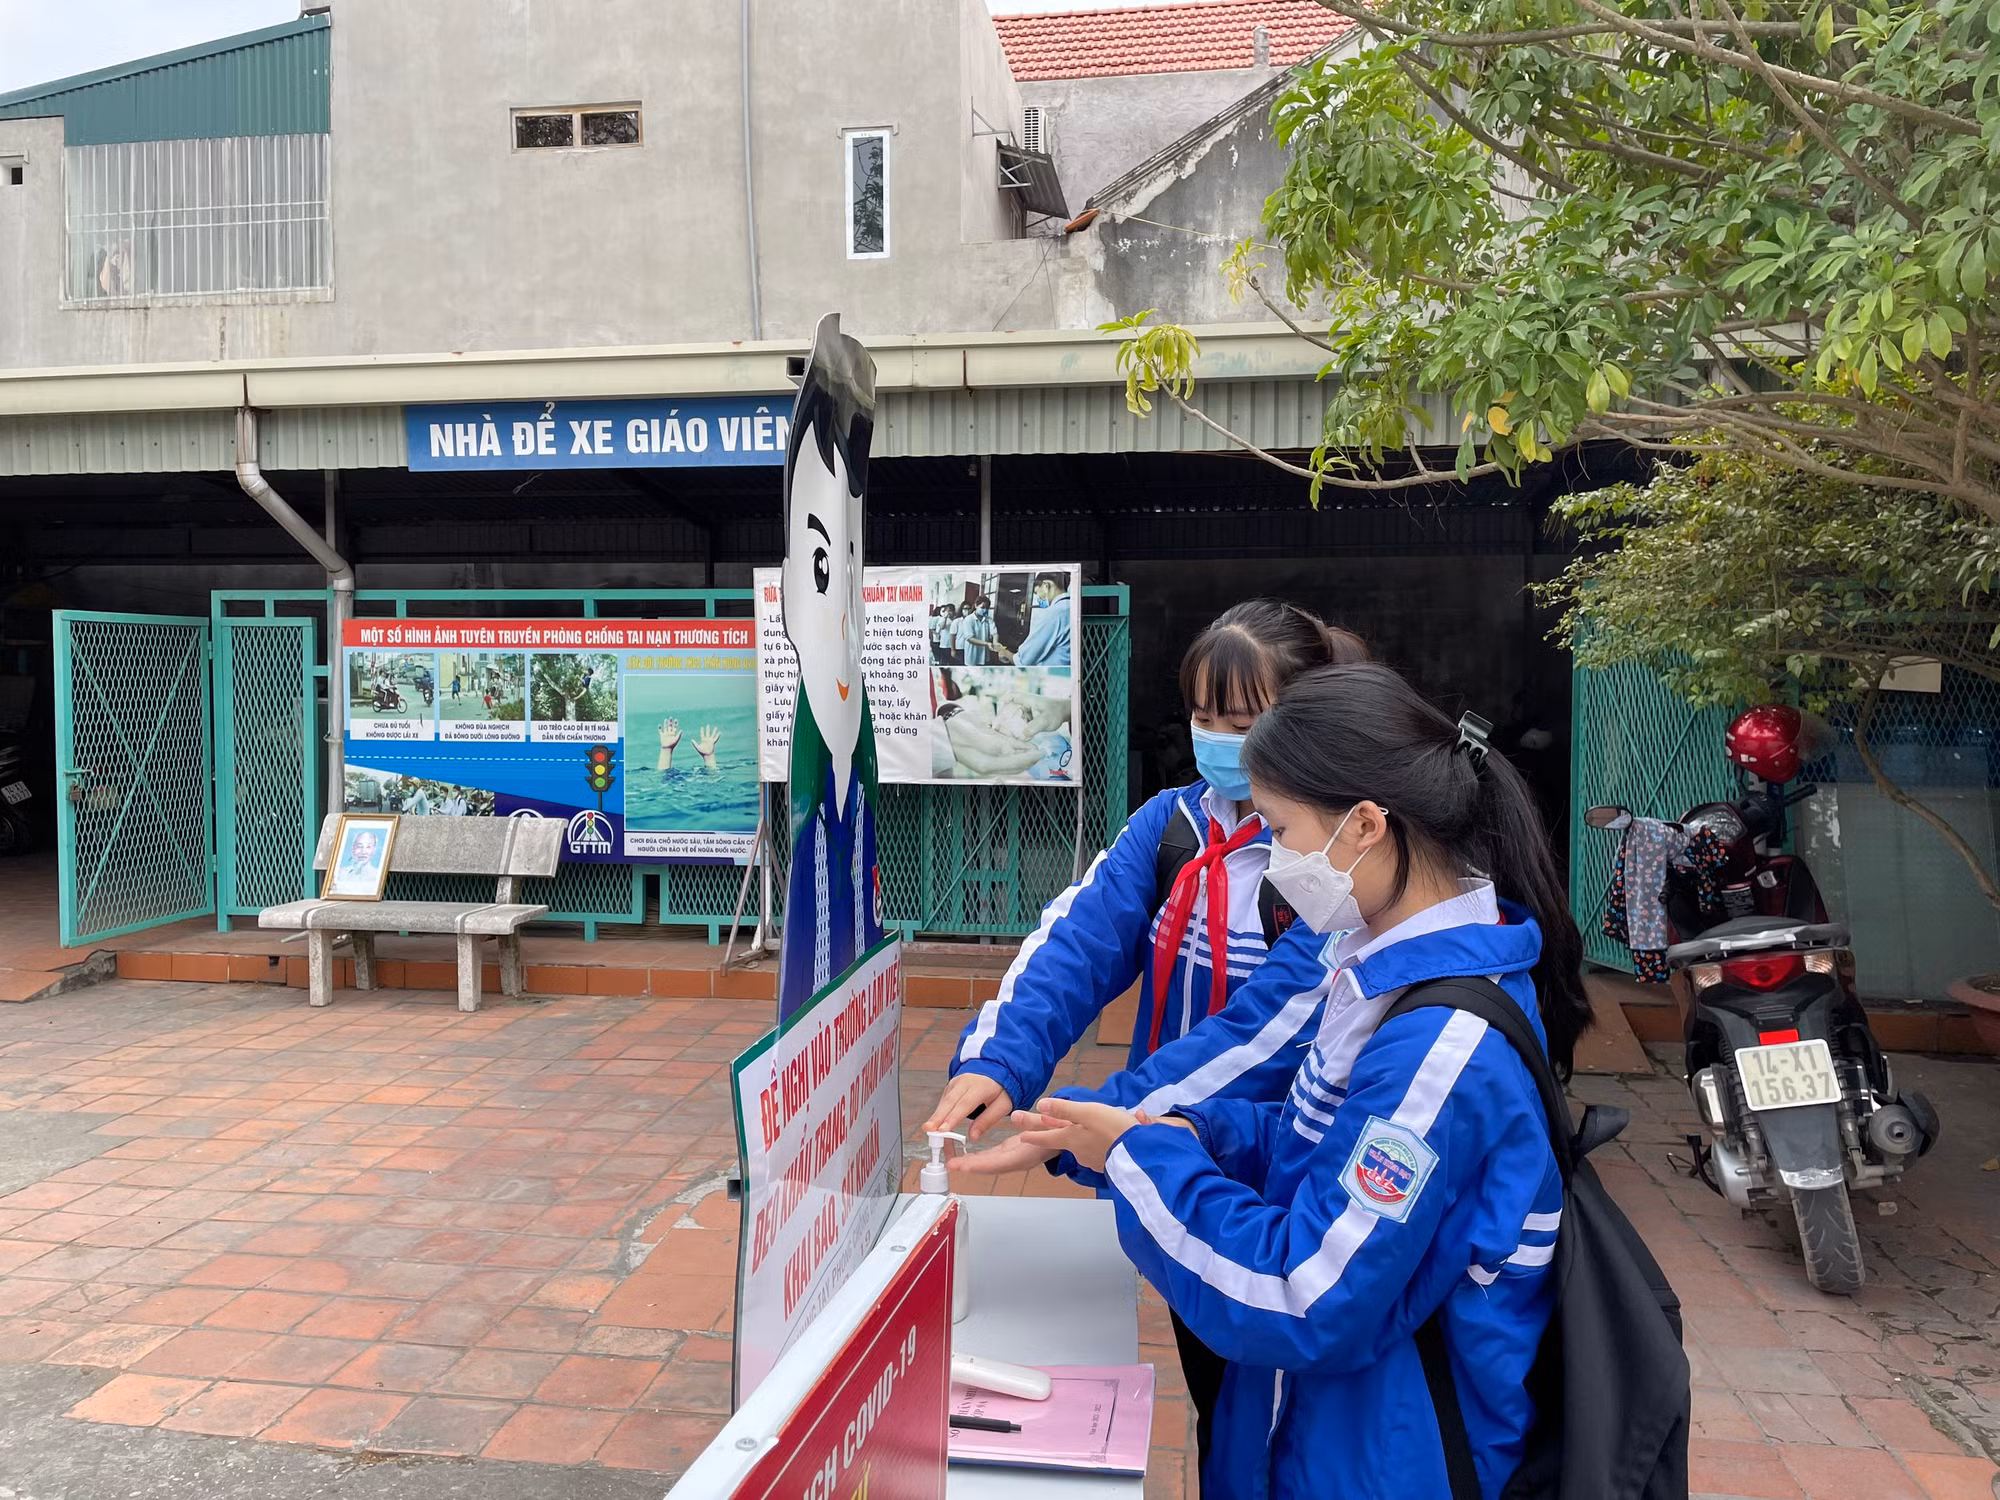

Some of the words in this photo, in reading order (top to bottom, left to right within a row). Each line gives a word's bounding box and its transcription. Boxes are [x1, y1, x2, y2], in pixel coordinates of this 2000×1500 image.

[430, 413, 502, 457] NHÀ
[512, 401, 557, 456] ĐỂ
[569, 420, 614, 454] XE
[625, 409, 708, 453] GIÁO
[887, 586, 897, 602] TAY
[900, 586, 923, 602] NHANH
[873, 615, 894, 623] theo
[897, 614, 914, 624] loại
[360, 627, 384, 646] MỘT
[387, 625, 402, 643] SỐ
[405, 627, 431, 643] HÌNH
[434, 625, 457, 643] ẢNH
[460, 627, 495, 644] TUYÊN
[544, 627, 582, 644] PHÒNG
[585, 626, 623, 644] CHỐNG
[627, 630, 643, 644] TAI
[646, 630, 670, 647] NẠN
[674, 628, 719, 644] THƯƠNG
[723, 627, 748, 644] TÍCH
[873, 628, 893, 638] hiện
[764, 643, 774, 652] tự
[775, 642, 781, 651] 6
[885, 642, 907, 652] sạch
[910, 641, 921, 651] và
[764, 656, 775, 665] xà
[778, 656, 799, 666] phò
[861, 656, 884, 666] động
[887, 656, 902, 665] tác
[904, 655, 925, 667] phải
[764, 670, 785, 680] thực
[869, 669, 904, 681] khoảng
[906, 670, 918, 679] 30
[765, 685, 784, 694] giây
[878, 684, 899, 693] khô.
[774, 698, 792, 706] Lưu
[878, 699, 894, 709] tay,
[897, 697, 911, 709] lấy
[765, 710, 785, 721] giấy
[879, 711, 901, 722] hoặc
[904, 711, 927, 721] khăn
[766, 725, 780, 733] lau
[874, 725, 891, 736] ông
[894, 726, 918, 737] dùng
[766, 739, 789, 747] khăn
[571, 841, 611, 854] GTTM
[760, 1059, 780, 1153] ĐỀ
[781, 1046, 810, 1129] NGHỊ
[811, 1021, 831, 1091] VÀO
[834, 989, 866, 1066] TRƯỜNG
[868, 971, 884, 1026] LÀM
[1752, 1044, 1818, 1077] 14-X1
[1752, 1071, 1830, 1106] 156.37
[752, 1185, 780, 1277] ĐEO
[780, 1123, 813, 1231] KHẨU
[814, 1095, 848, 1181] TRANG,
[850, 1075, 860, 1130] ĐO
[861, 1045, 880, 1111] THÂN
[784, 1228, 812, 1322] KHAI
[814, 1192, 840, 1271] BÁO,
[856, 1107, 881, 1198] KHUẨN
[817, 1278, 831, 1312] TAY
[843, 1324, 917, 1470] COVID-19
